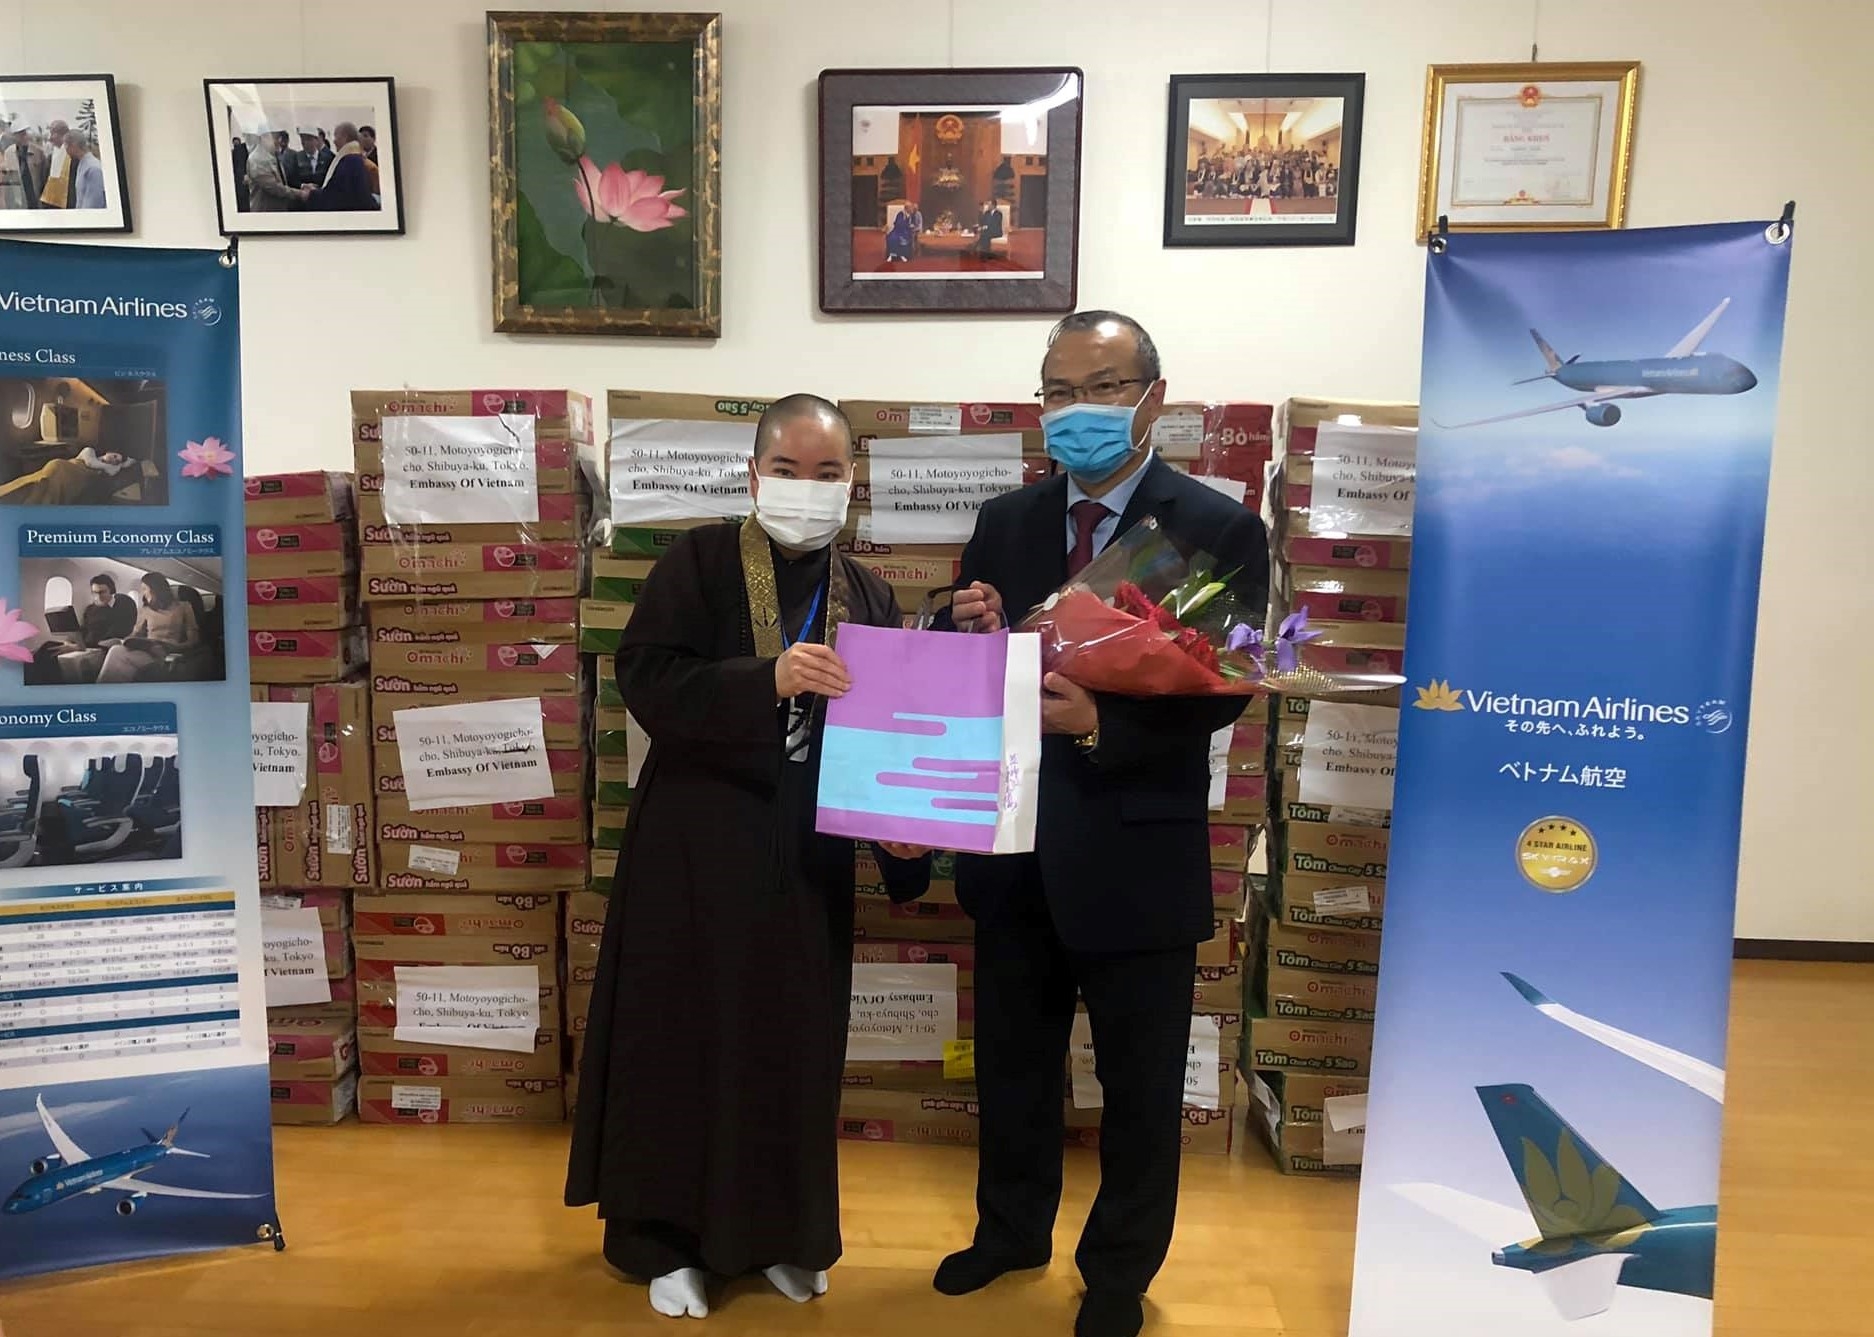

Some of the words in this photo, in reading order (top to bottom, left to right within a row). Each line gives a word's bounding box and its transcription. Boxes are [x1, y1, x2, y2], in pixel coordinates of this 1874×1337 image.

[0, 291, 98, 316] Vietnam
[100, 296, 188, 319] Airlines
[35, 349, 76, 364] Class
[739, 402, 749, 414] 5
[667, 451, 748, 464] Motoyoyogicho
[718, 469, 749, 480] Tokyo
[409, 478, 458, 491] Embassy
[460, 478, 474, 489] Of
[477, 478, 525, 489] Vietnam
[633, 480, 681, 492] Embassy
[684, 483, 698, 494] Of
[700, 484, 748, 495] Vietnam
[1337, 488, 1389, 501] Embassy
[1393, 488, 1411, 501] Of
[895, 501, 941, 513] Embassy
[945, 500, 960, 511] Of
[27, 529, 98, 545] Premium
[101, 530, 172, 547] Economy
[176, 529, 215, 544] Class
[369, 579, 407, 594] Sườn
[377, 628, 413, 643] Sườn
[375, 677, 411, 692] Sườn
[1466, 689, 1578, 719] Vietnam
[1582, 696, 1689, 725] Airlines
[57, 709, 97, 724] Class
[1505, 718, 1645, 741] その先へ、ふれよう。
[1349, 750, 1397, 763] Shibuya-
[252, 761, 295, 773] Vietnam
[426, 766, 473, 779] Embassy
[475, 762, 490, 772] Of
[492, 759, 538, 771] Vietnam
[1326, 761, 1376, 777] Embassy
[1499, 761, 1627, 789] ベトナム航空
[1289, 804, 1321, 820] Tôm
[382, 825, 418, 840] Sườn
[1533, 840, 1554, 849] STAR
[1556, 843, 1587, 852] AIRLINE
[306, 846, 320, 881] Sườn
[352, 847, 369, 884] Sườn
[1296, 855, 1327, 870] Tôm
[1365, 865, 1374, 875] 5
[74, 882, 145, 894] サービス案内
[387, 875, 424, 889] Sườn
[1279, 951, 1309, 967] Tôm
[270, 966, 315, 976] Vietnam
[869, 994, 885, 1003] Of
[887, 993, 933, 1004] Embassy
[1277, 1001, 1308, 1016] Tôm
[1256, 1051, 1287, 1066] Tôm
[1324, 1055, 1333, 1066] 5
[1189, 1111, 1208, 1124] Bò
[1293, 1107, 1323, 1121] Tôm
[1292, 1156, 1323, 1171] Tôm
